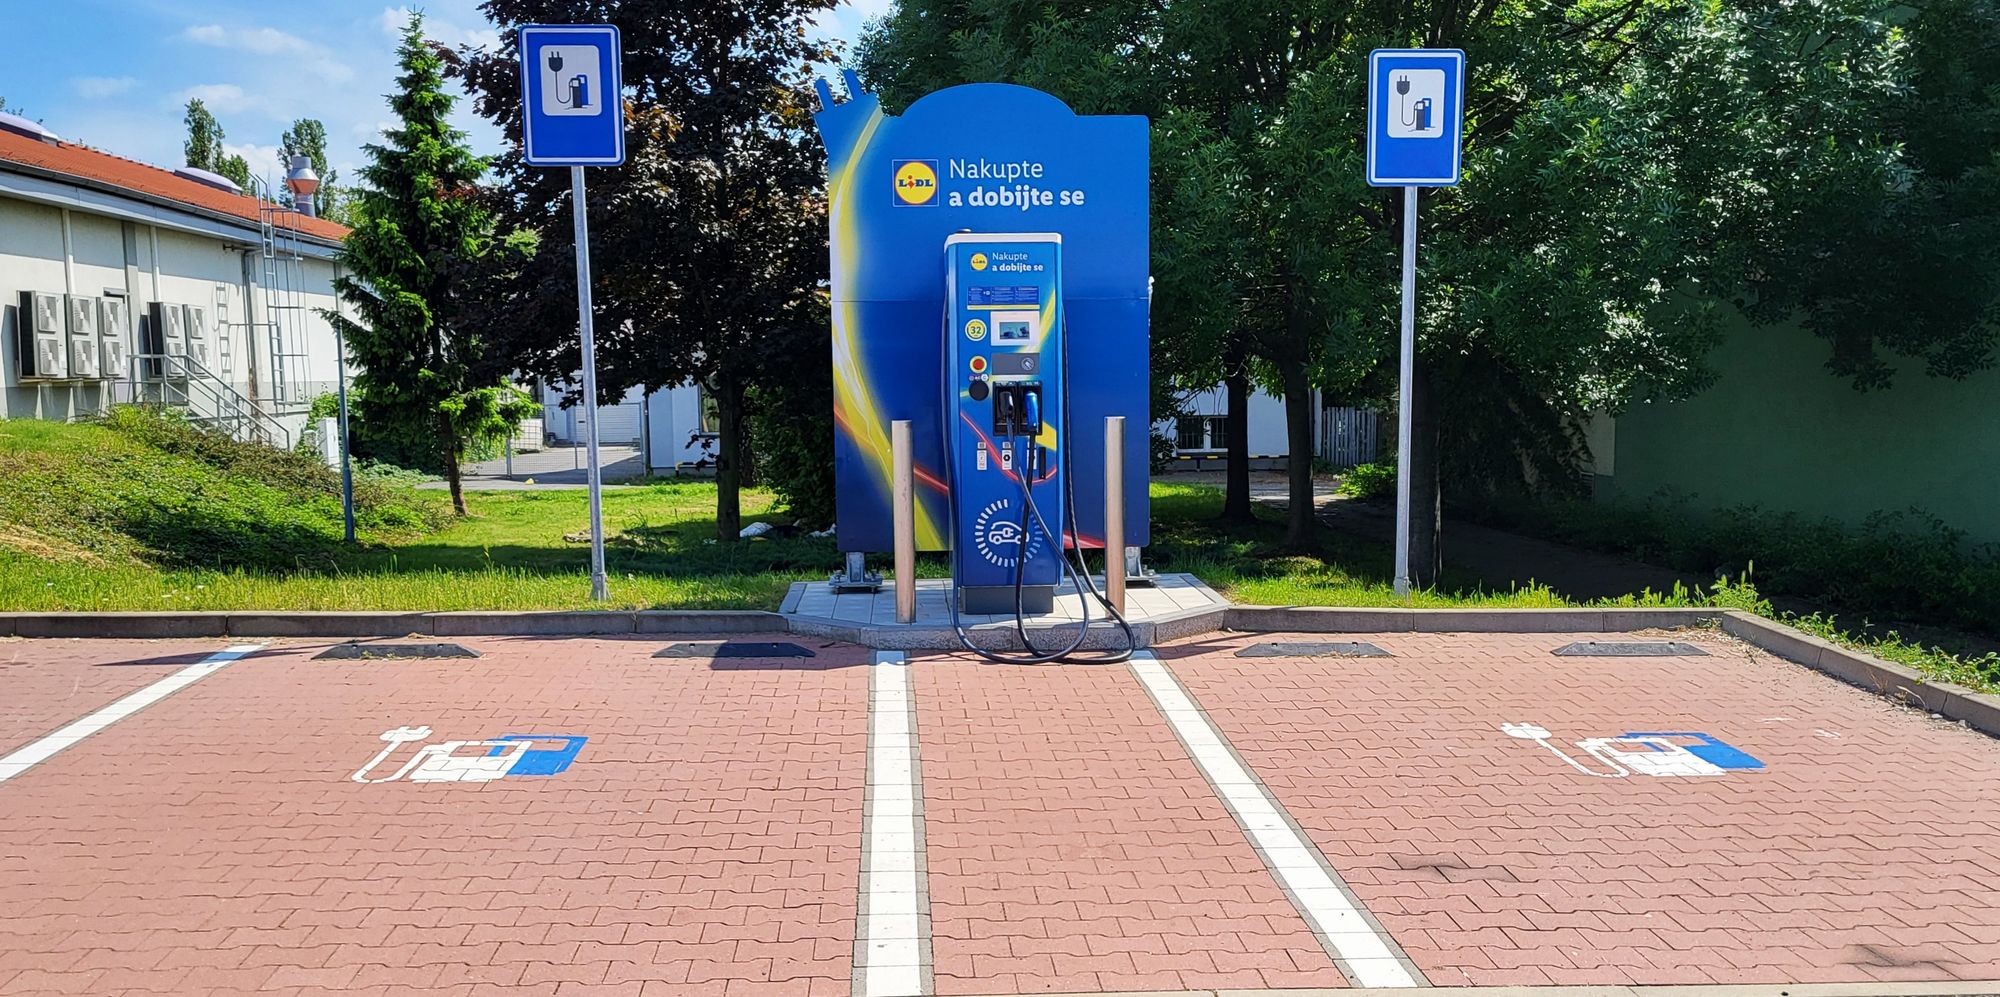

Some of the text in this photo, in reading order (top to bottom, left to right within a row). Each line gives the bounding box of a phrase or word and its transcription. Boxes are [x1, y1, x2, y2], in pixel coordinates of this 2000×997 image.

[949, 158, 1044, 183] Nakupte
[949, 185, 1085, 211] a dobijte se
[992, 252, 1028, 262] Nakupte
[999, 263, 1032, 273] dobijte
[1033, 264, 1044, 272] se
[970, 326, 982, 335] 32
